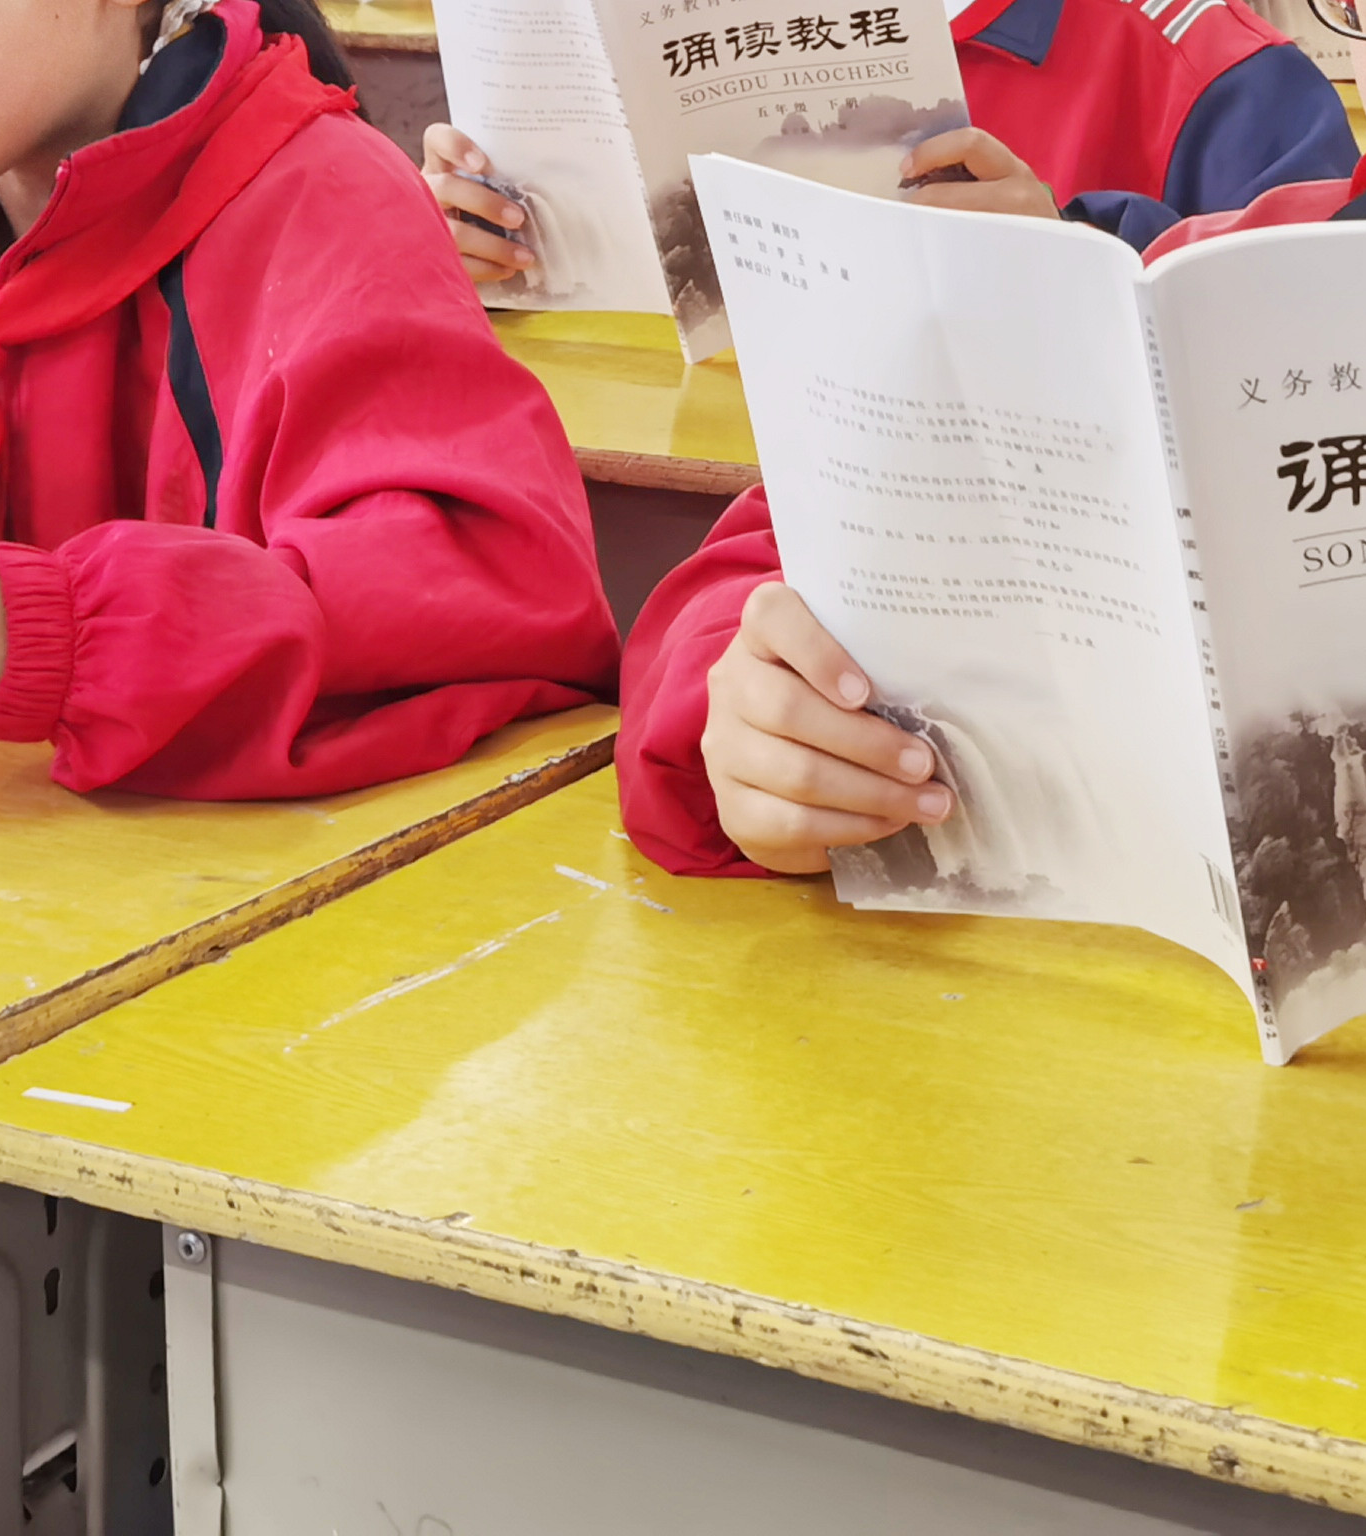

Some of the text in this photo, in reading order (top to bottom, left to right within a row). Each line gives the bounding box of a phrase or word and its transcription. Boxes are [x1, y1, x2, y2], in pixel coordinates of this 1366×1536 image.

[661, 7, 910, 77] 诵读教程
[679, 59, 910, 108] SONGDU JIAOCHENG
